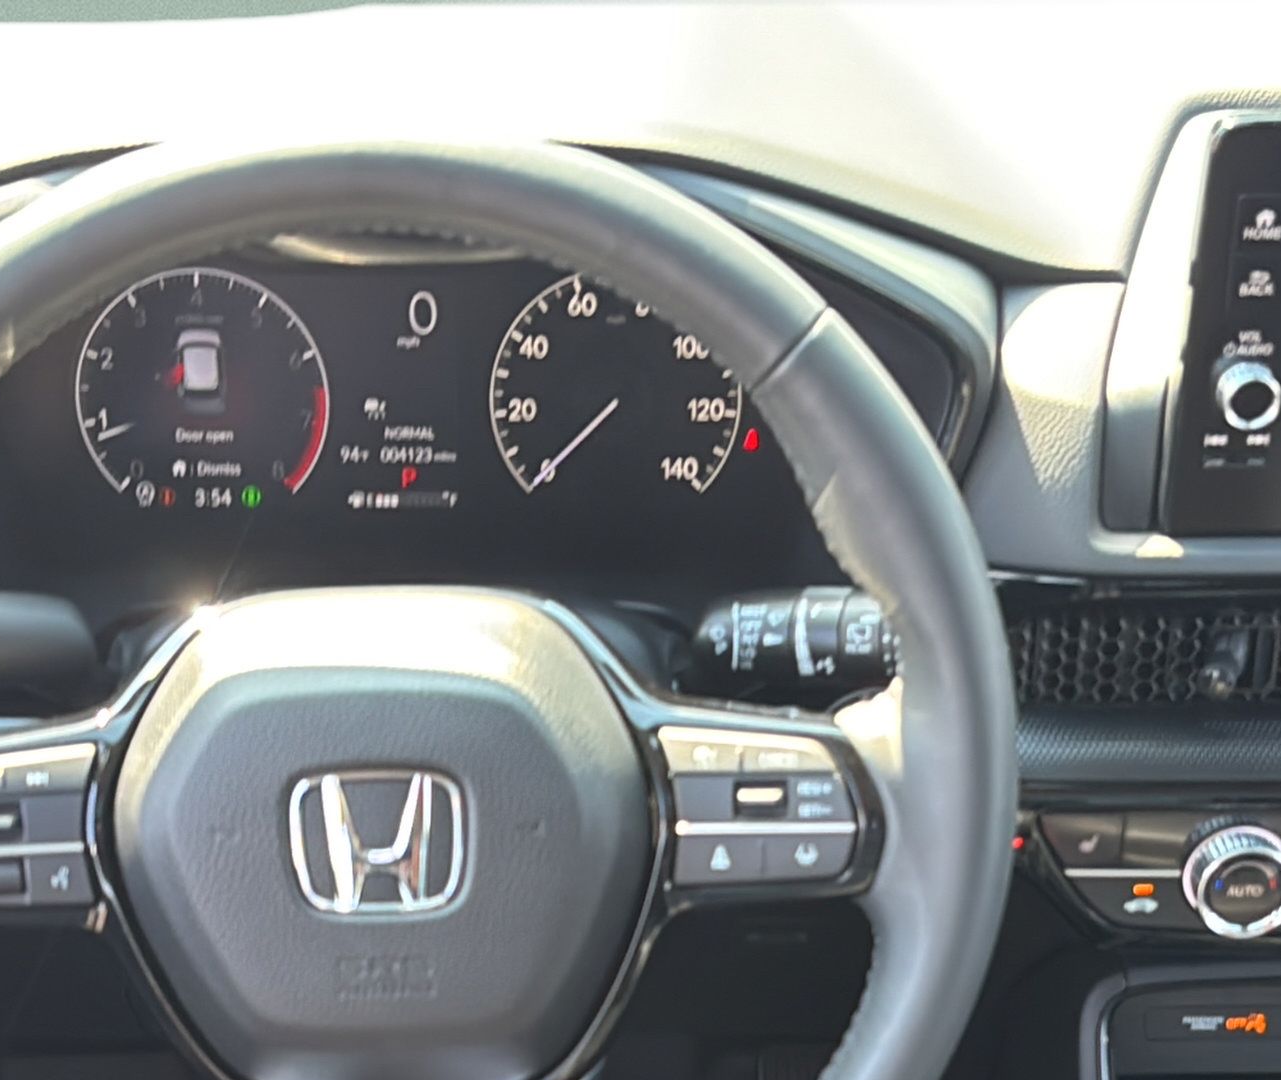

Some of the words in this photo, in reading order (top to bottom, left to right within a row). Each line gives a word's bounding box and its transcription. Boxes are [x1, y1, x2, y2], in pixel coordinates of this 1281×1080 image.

[1239, 282, 1274, 297] BACK
[408, 290, 438, 336] 0
[567, 292, 598, 317] 60
[100, 346, 114, 371] 2
[519, 334, 549, 360] 40
[97, 407, 108, 431] 1
[508, 397, 537, 422] 20
[687, 397, 725, 422] 120
[175, 427, 204, 444] Door
[206, 429, 234, 447] open
[380, 445, 433, 464] 004123
[197, 461, 242, 478] Dismiss
[401, 467, 417, 488] P
[660, 456, 699, 481] 140
[194, 488, 233, 508] 3:54
[1226, 885, 1265, 898] AUTO
